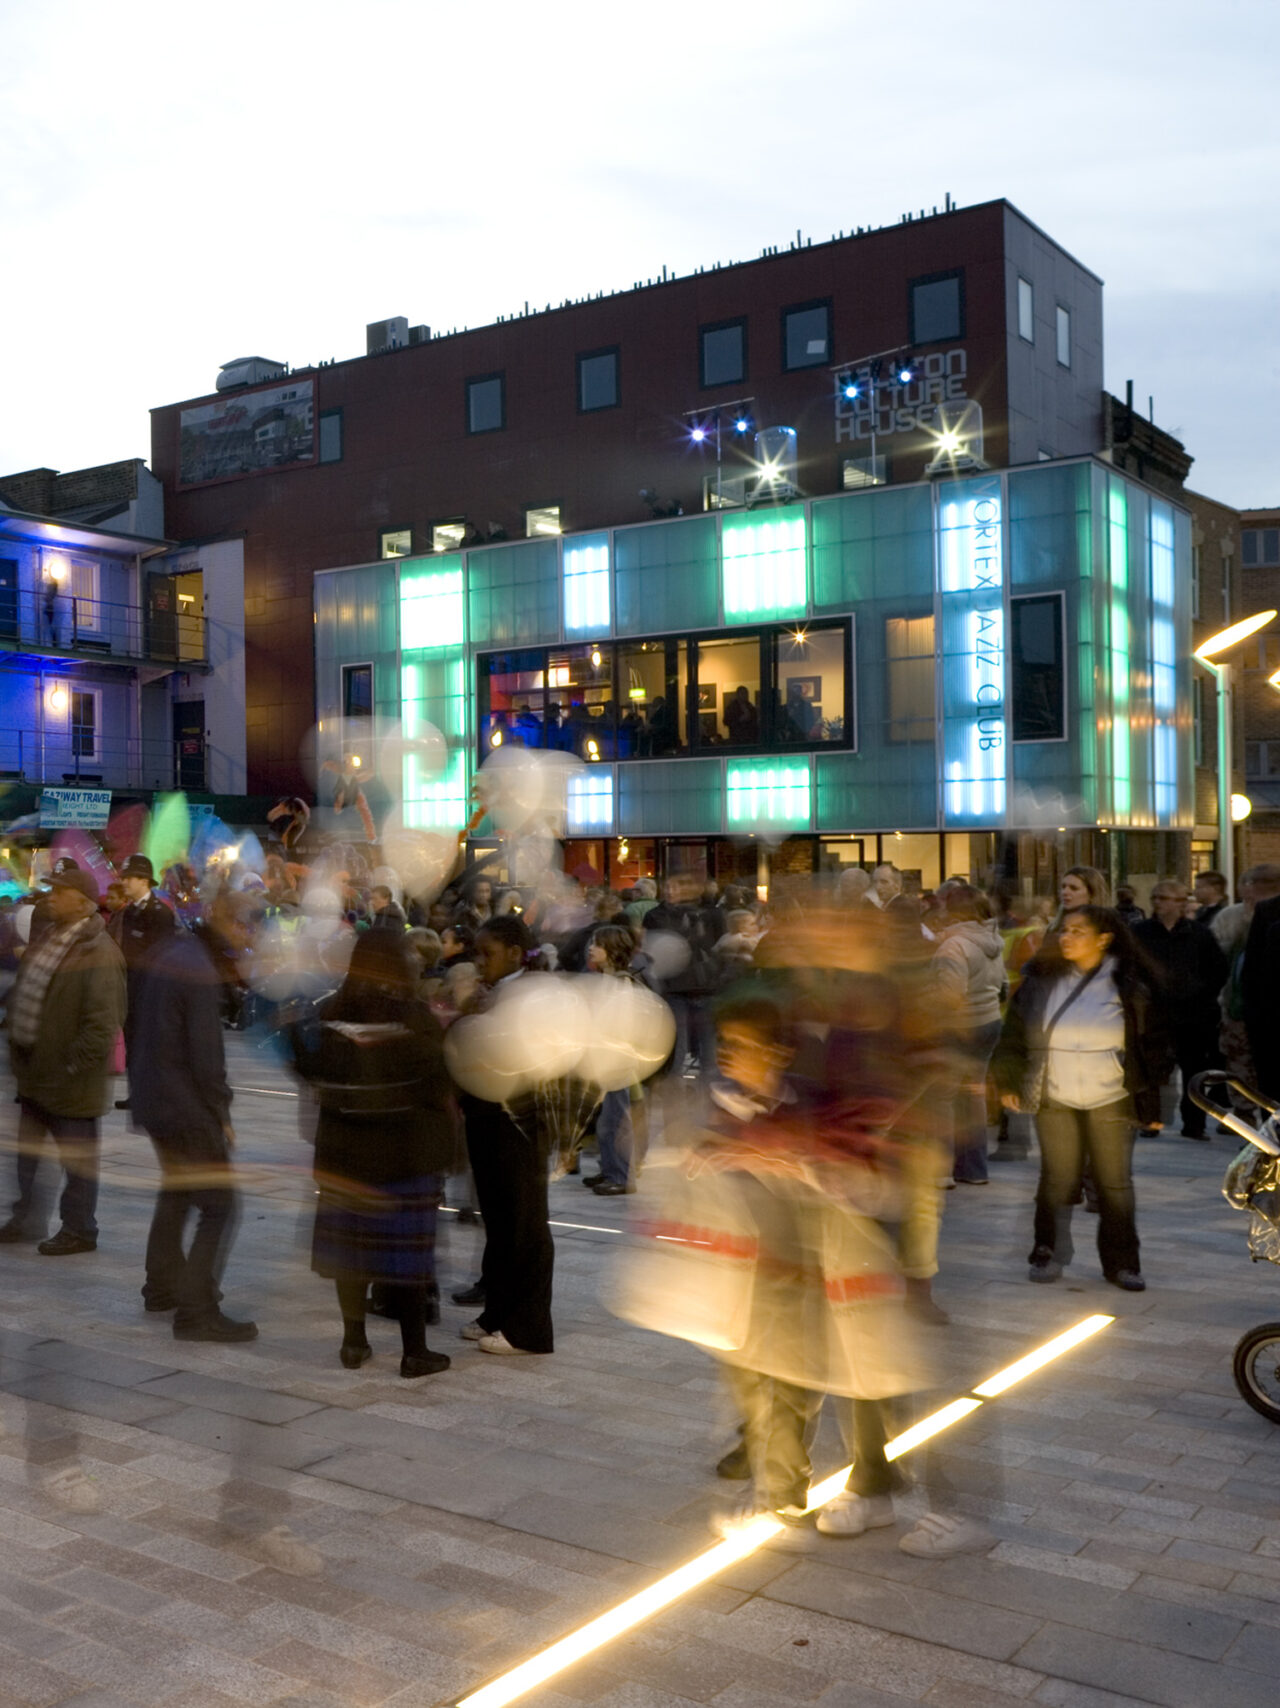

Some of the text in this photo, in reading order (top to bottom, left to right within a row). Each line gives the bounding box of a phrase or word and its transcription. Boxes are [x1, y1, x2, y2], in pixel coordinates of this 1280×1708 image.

[835, 373, 967, 419] CULTURE
[835, 403, 936, 443] HOUSE
[973, 480, 1002, 751] VORTEX JAZZ CLUB
[82, 792, 111, 803] TRAVEL
